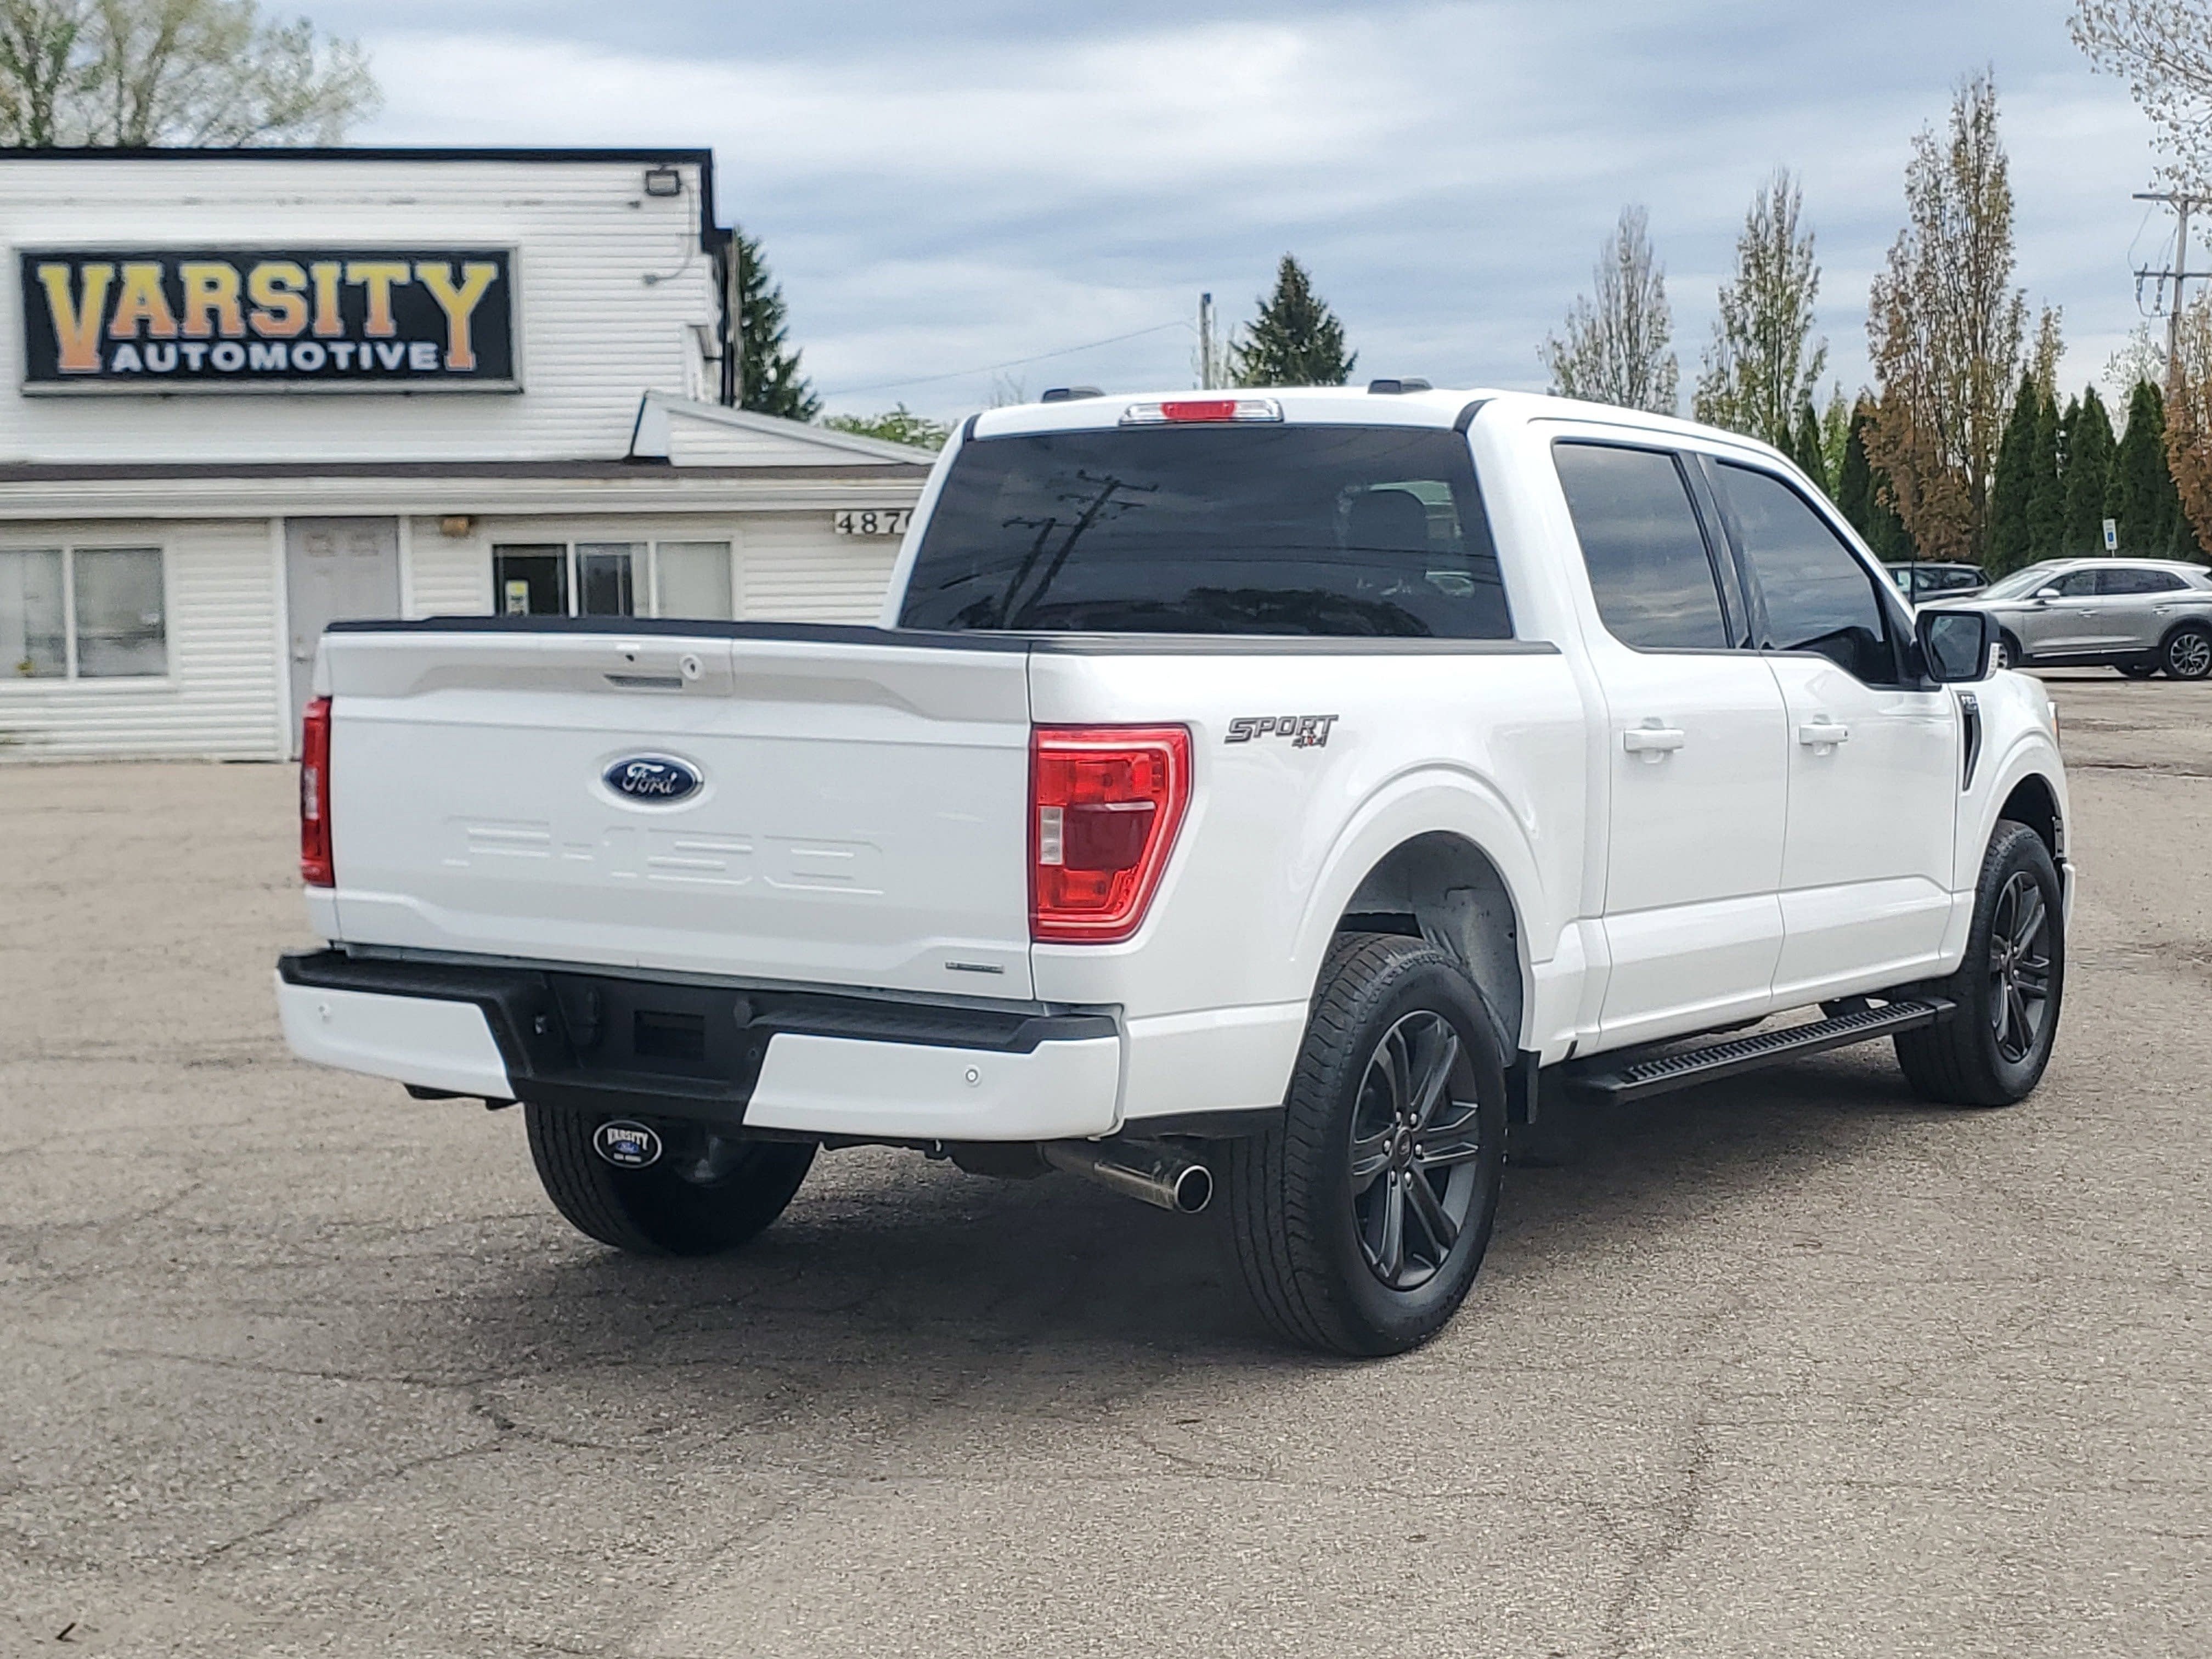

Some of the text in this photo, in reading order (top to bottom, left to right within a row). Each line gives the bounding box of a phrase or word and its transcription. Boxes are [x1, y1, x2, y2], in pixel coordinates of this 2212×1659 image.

[38, 260, 498, 374] VARSITY
[111, 342, 439, 372] AUTOMOTIVE
[1224, 714, 1339, 744] SPORT
[622, 763, 678, 793] Ford
